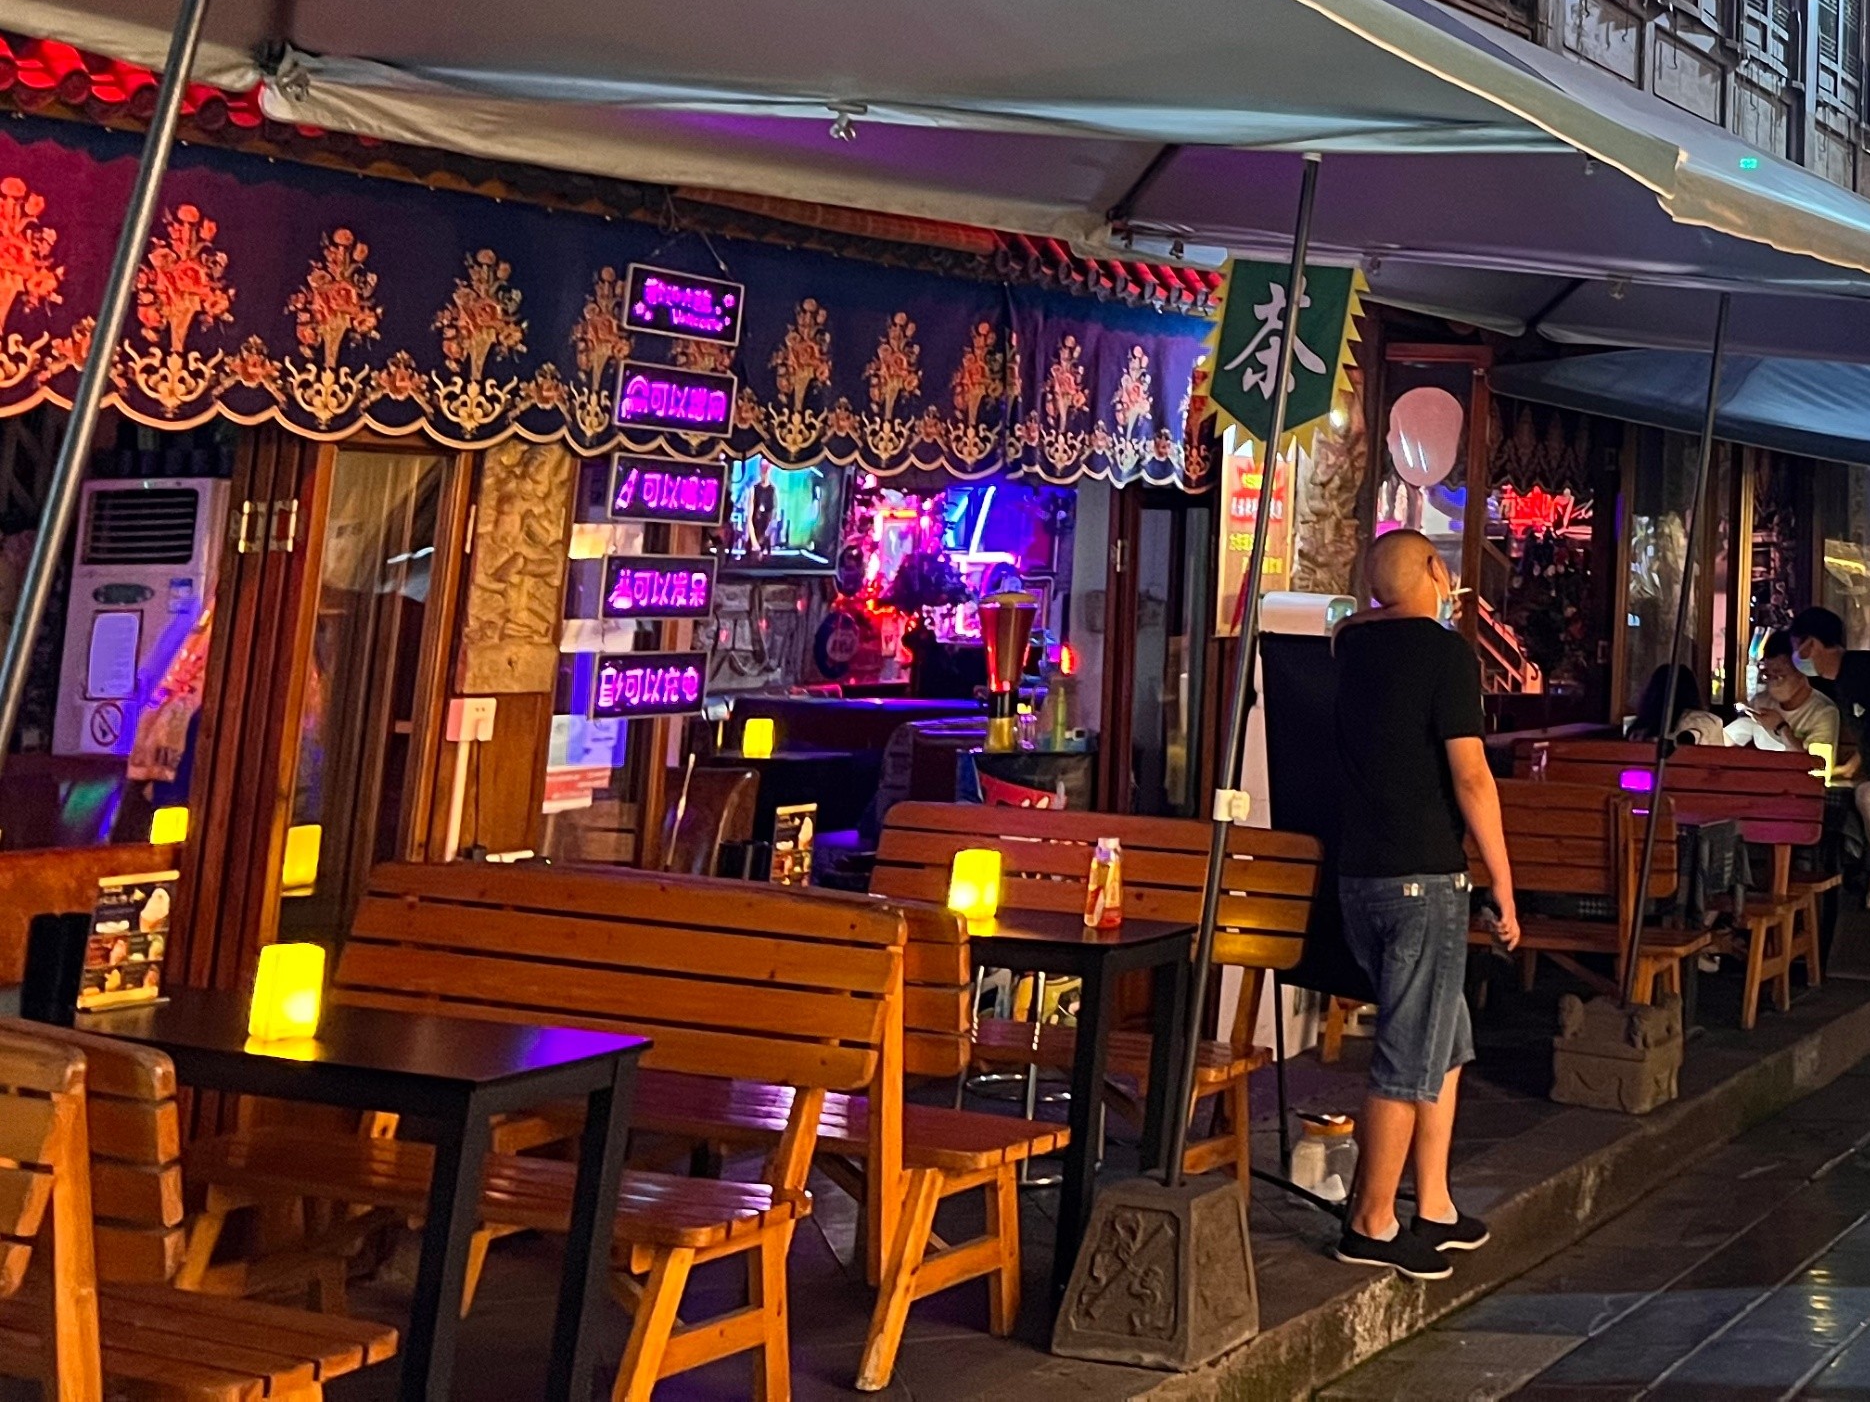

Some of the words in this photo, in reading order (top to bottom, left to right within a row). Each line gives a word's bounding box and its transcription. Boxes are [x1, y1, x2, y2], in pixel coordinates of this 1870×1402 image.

[1223, 276, 1327, 400] 茶
[634, 571, 708, 608] 可以发呆
[624, 665, 699, 706] 可以充电
